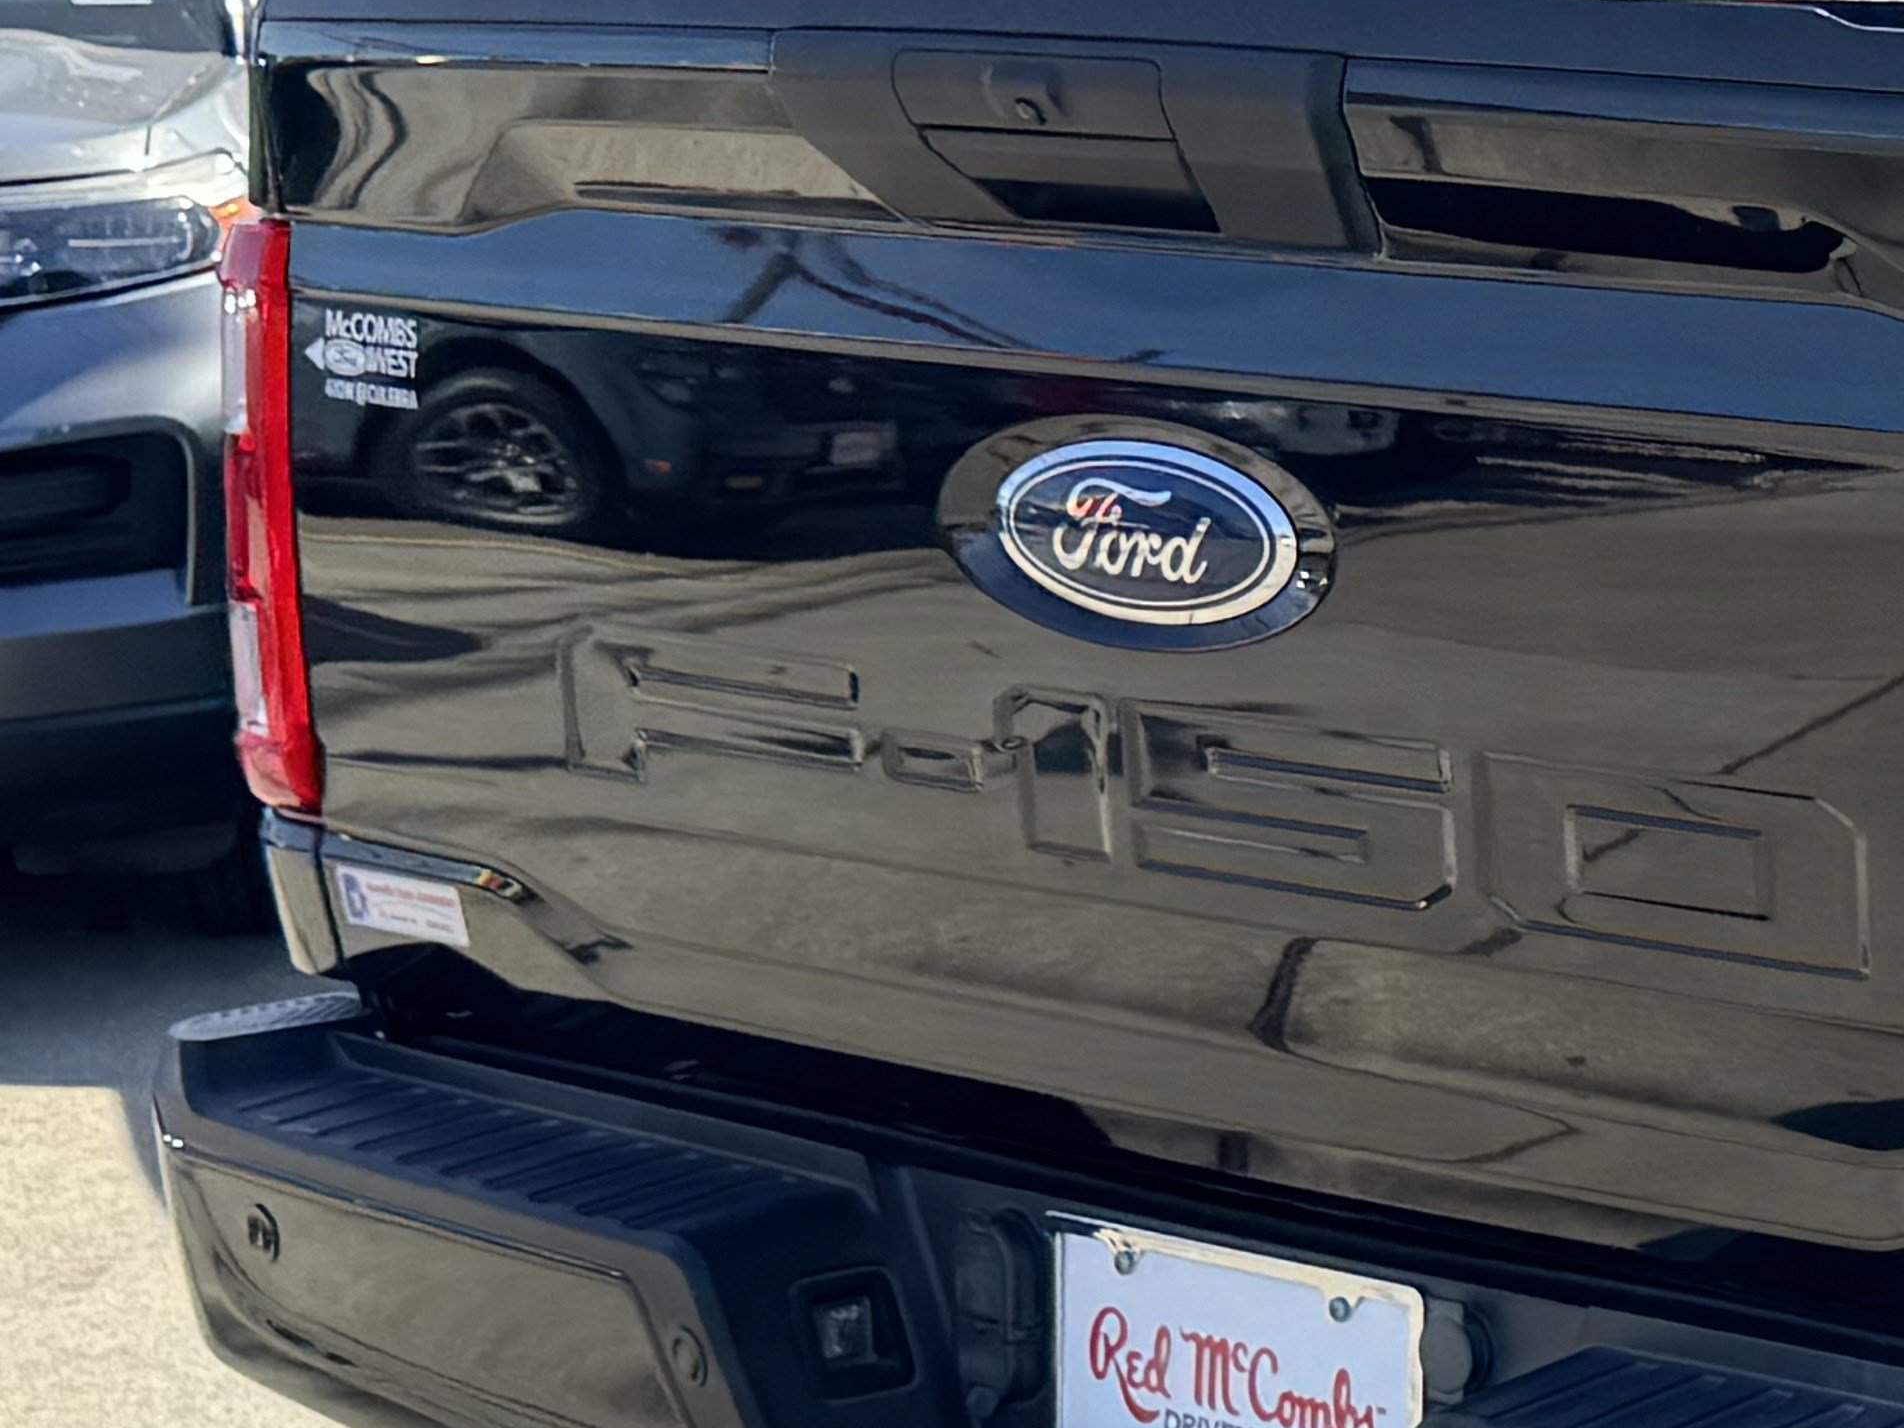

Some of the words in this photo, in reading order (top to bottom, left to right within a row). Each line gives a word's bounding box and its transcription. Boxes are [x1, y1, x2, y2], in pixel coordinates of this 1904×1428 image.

[365, 346, 419, 380] WEST
[1053, 478, 1211, 587] Ford
[559, 620, 1872, 982] F-150
[1089, 1306, 1172, 1424] Red
